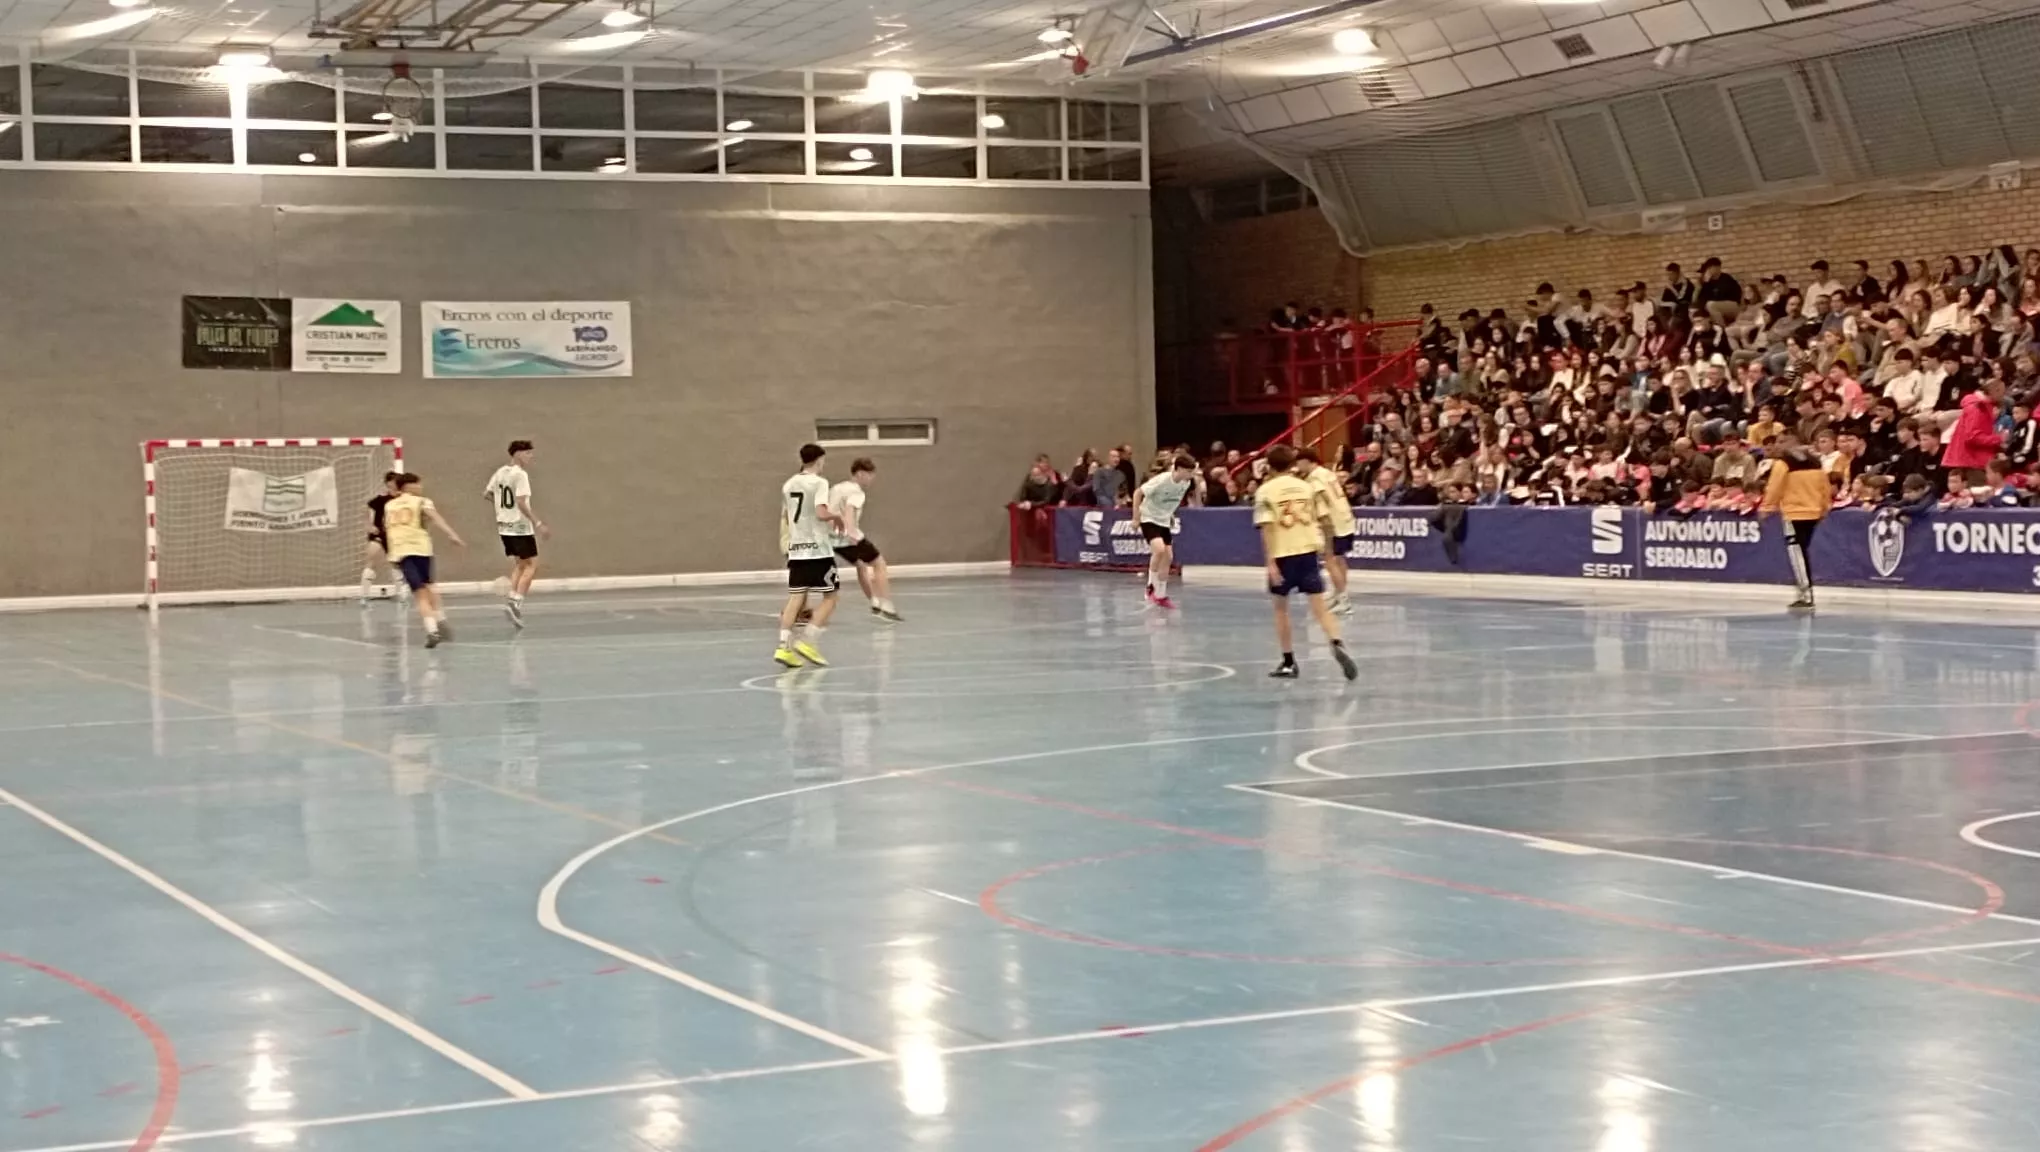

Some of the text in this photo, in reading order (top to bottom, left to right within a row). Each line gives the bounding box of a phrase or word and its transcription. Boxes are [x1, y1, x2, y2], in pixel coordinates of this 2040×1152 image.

[441, 309, 613, 323] Ercros con el deporte
[306, 331, 353, 339] CRISTIAN
[465, 333, 521, 350] Ercros
[499, 484, 514, 509] 10
[790, 492, 804, 524] 7
[1645, 516, 1760, 543] AUTOMÓVILES
[1645, 547, 1728, 569] SERRABLO
[1582, 563, 1633, 577] SEAT
